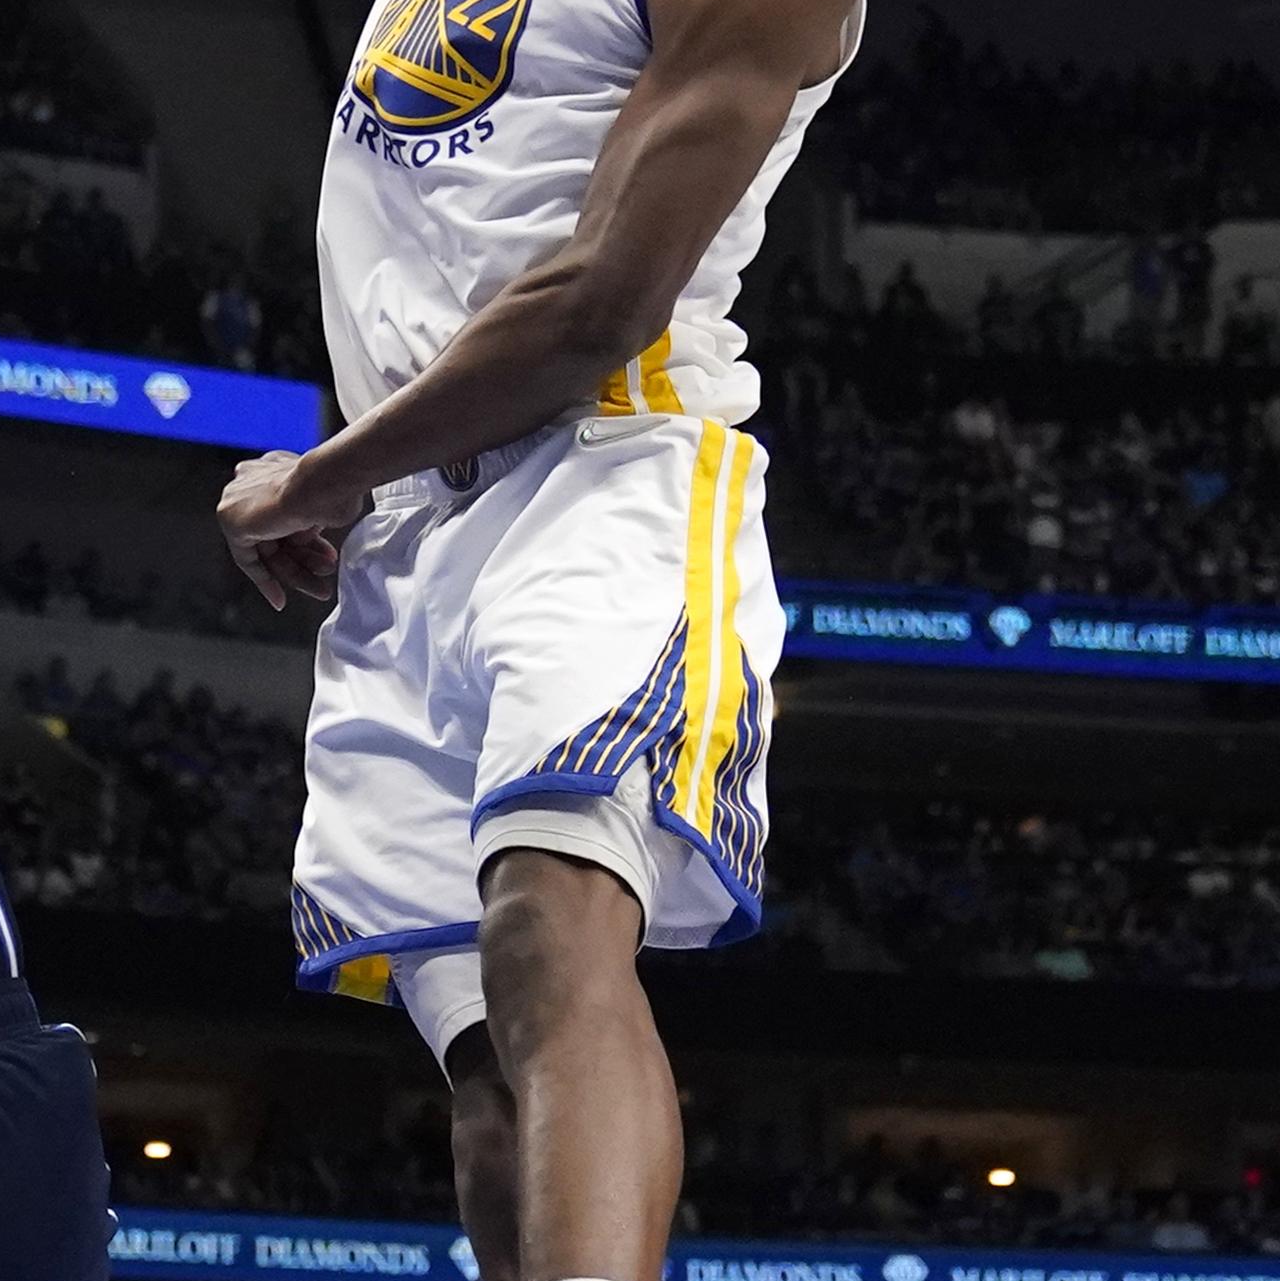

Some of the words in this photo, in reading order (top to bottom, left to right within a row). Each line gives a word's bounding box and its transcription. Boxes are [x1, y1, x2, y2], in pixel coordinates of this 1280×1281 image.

[337, 96, 495, 169] ARRIORS
[813, 603, 972, 642] DIAMONDS
[255, 1235, 431, 1276] DIAMONDS
